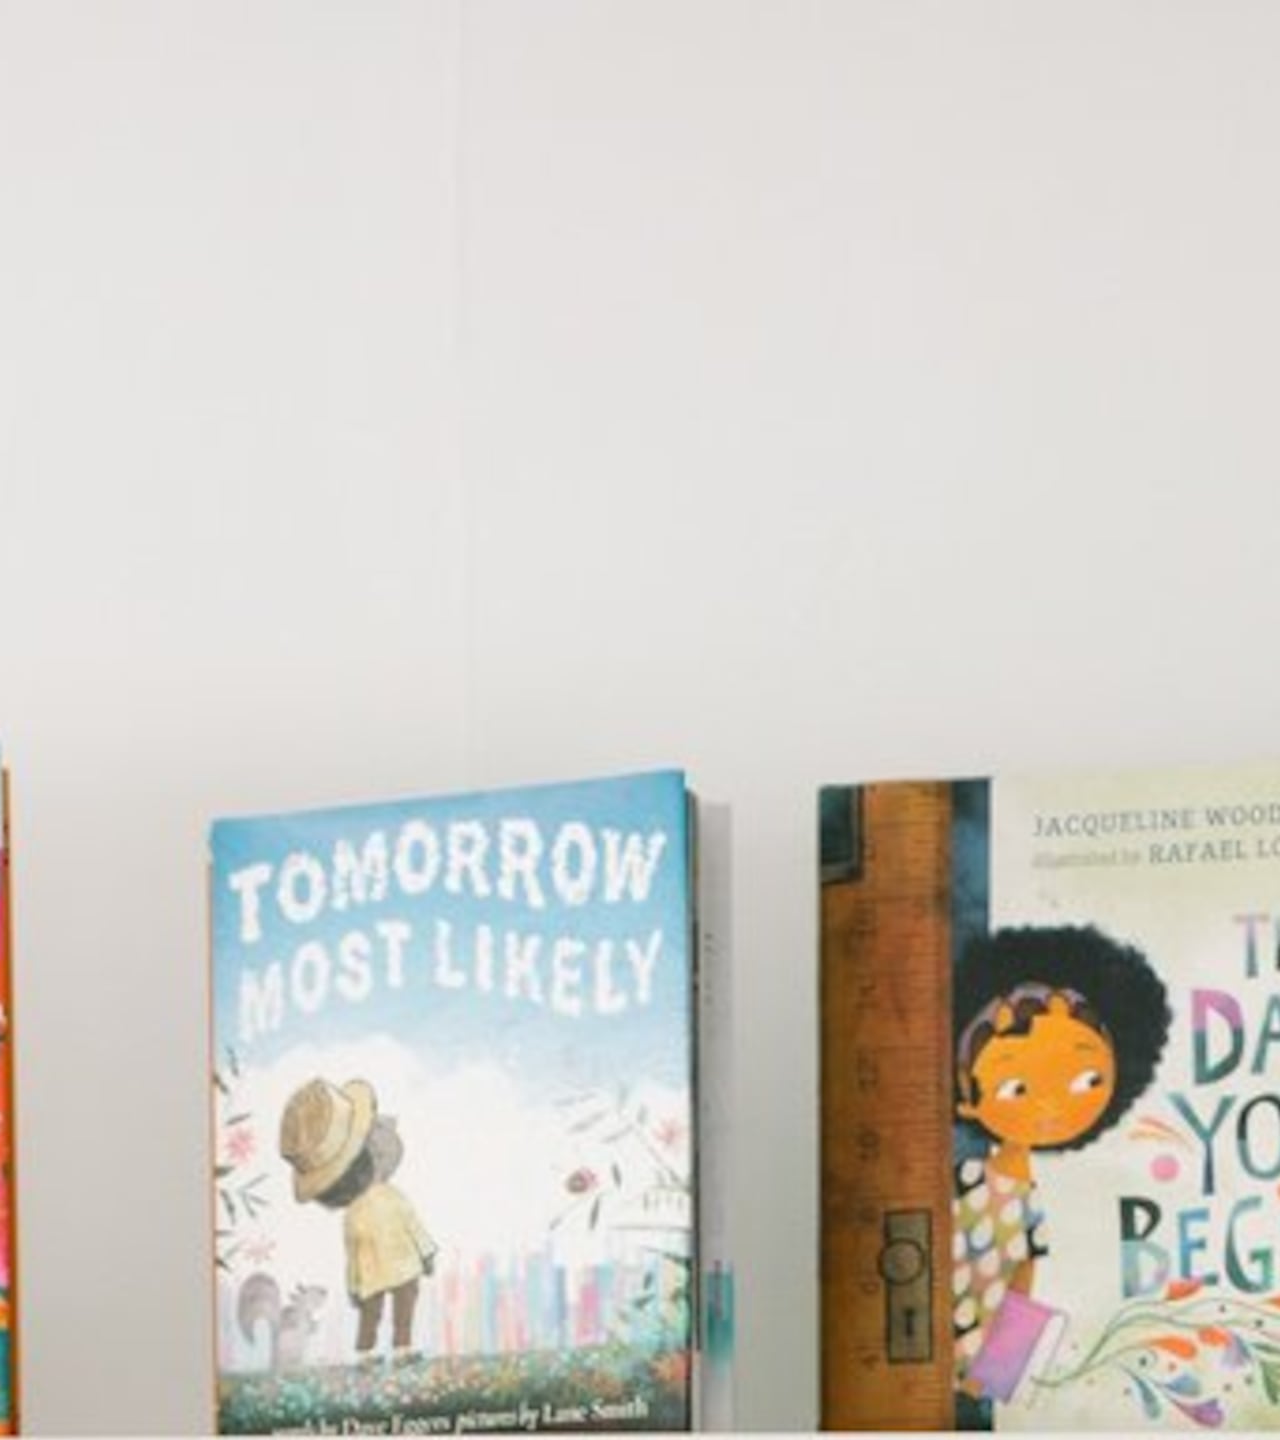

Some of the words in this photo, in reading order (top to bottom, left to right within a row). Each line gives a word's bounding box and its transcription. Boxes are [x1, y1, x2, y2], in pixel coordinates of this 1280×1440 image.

[1033, 808, 1197, 838] JACQUELINE
[1149, 839, 1249, 865] RAFAEL
[229, 819, 667, 943] TOMORROW
[237, 920, 411, 1042] MOST
[434, 919, 663, 1017] LIKELY
